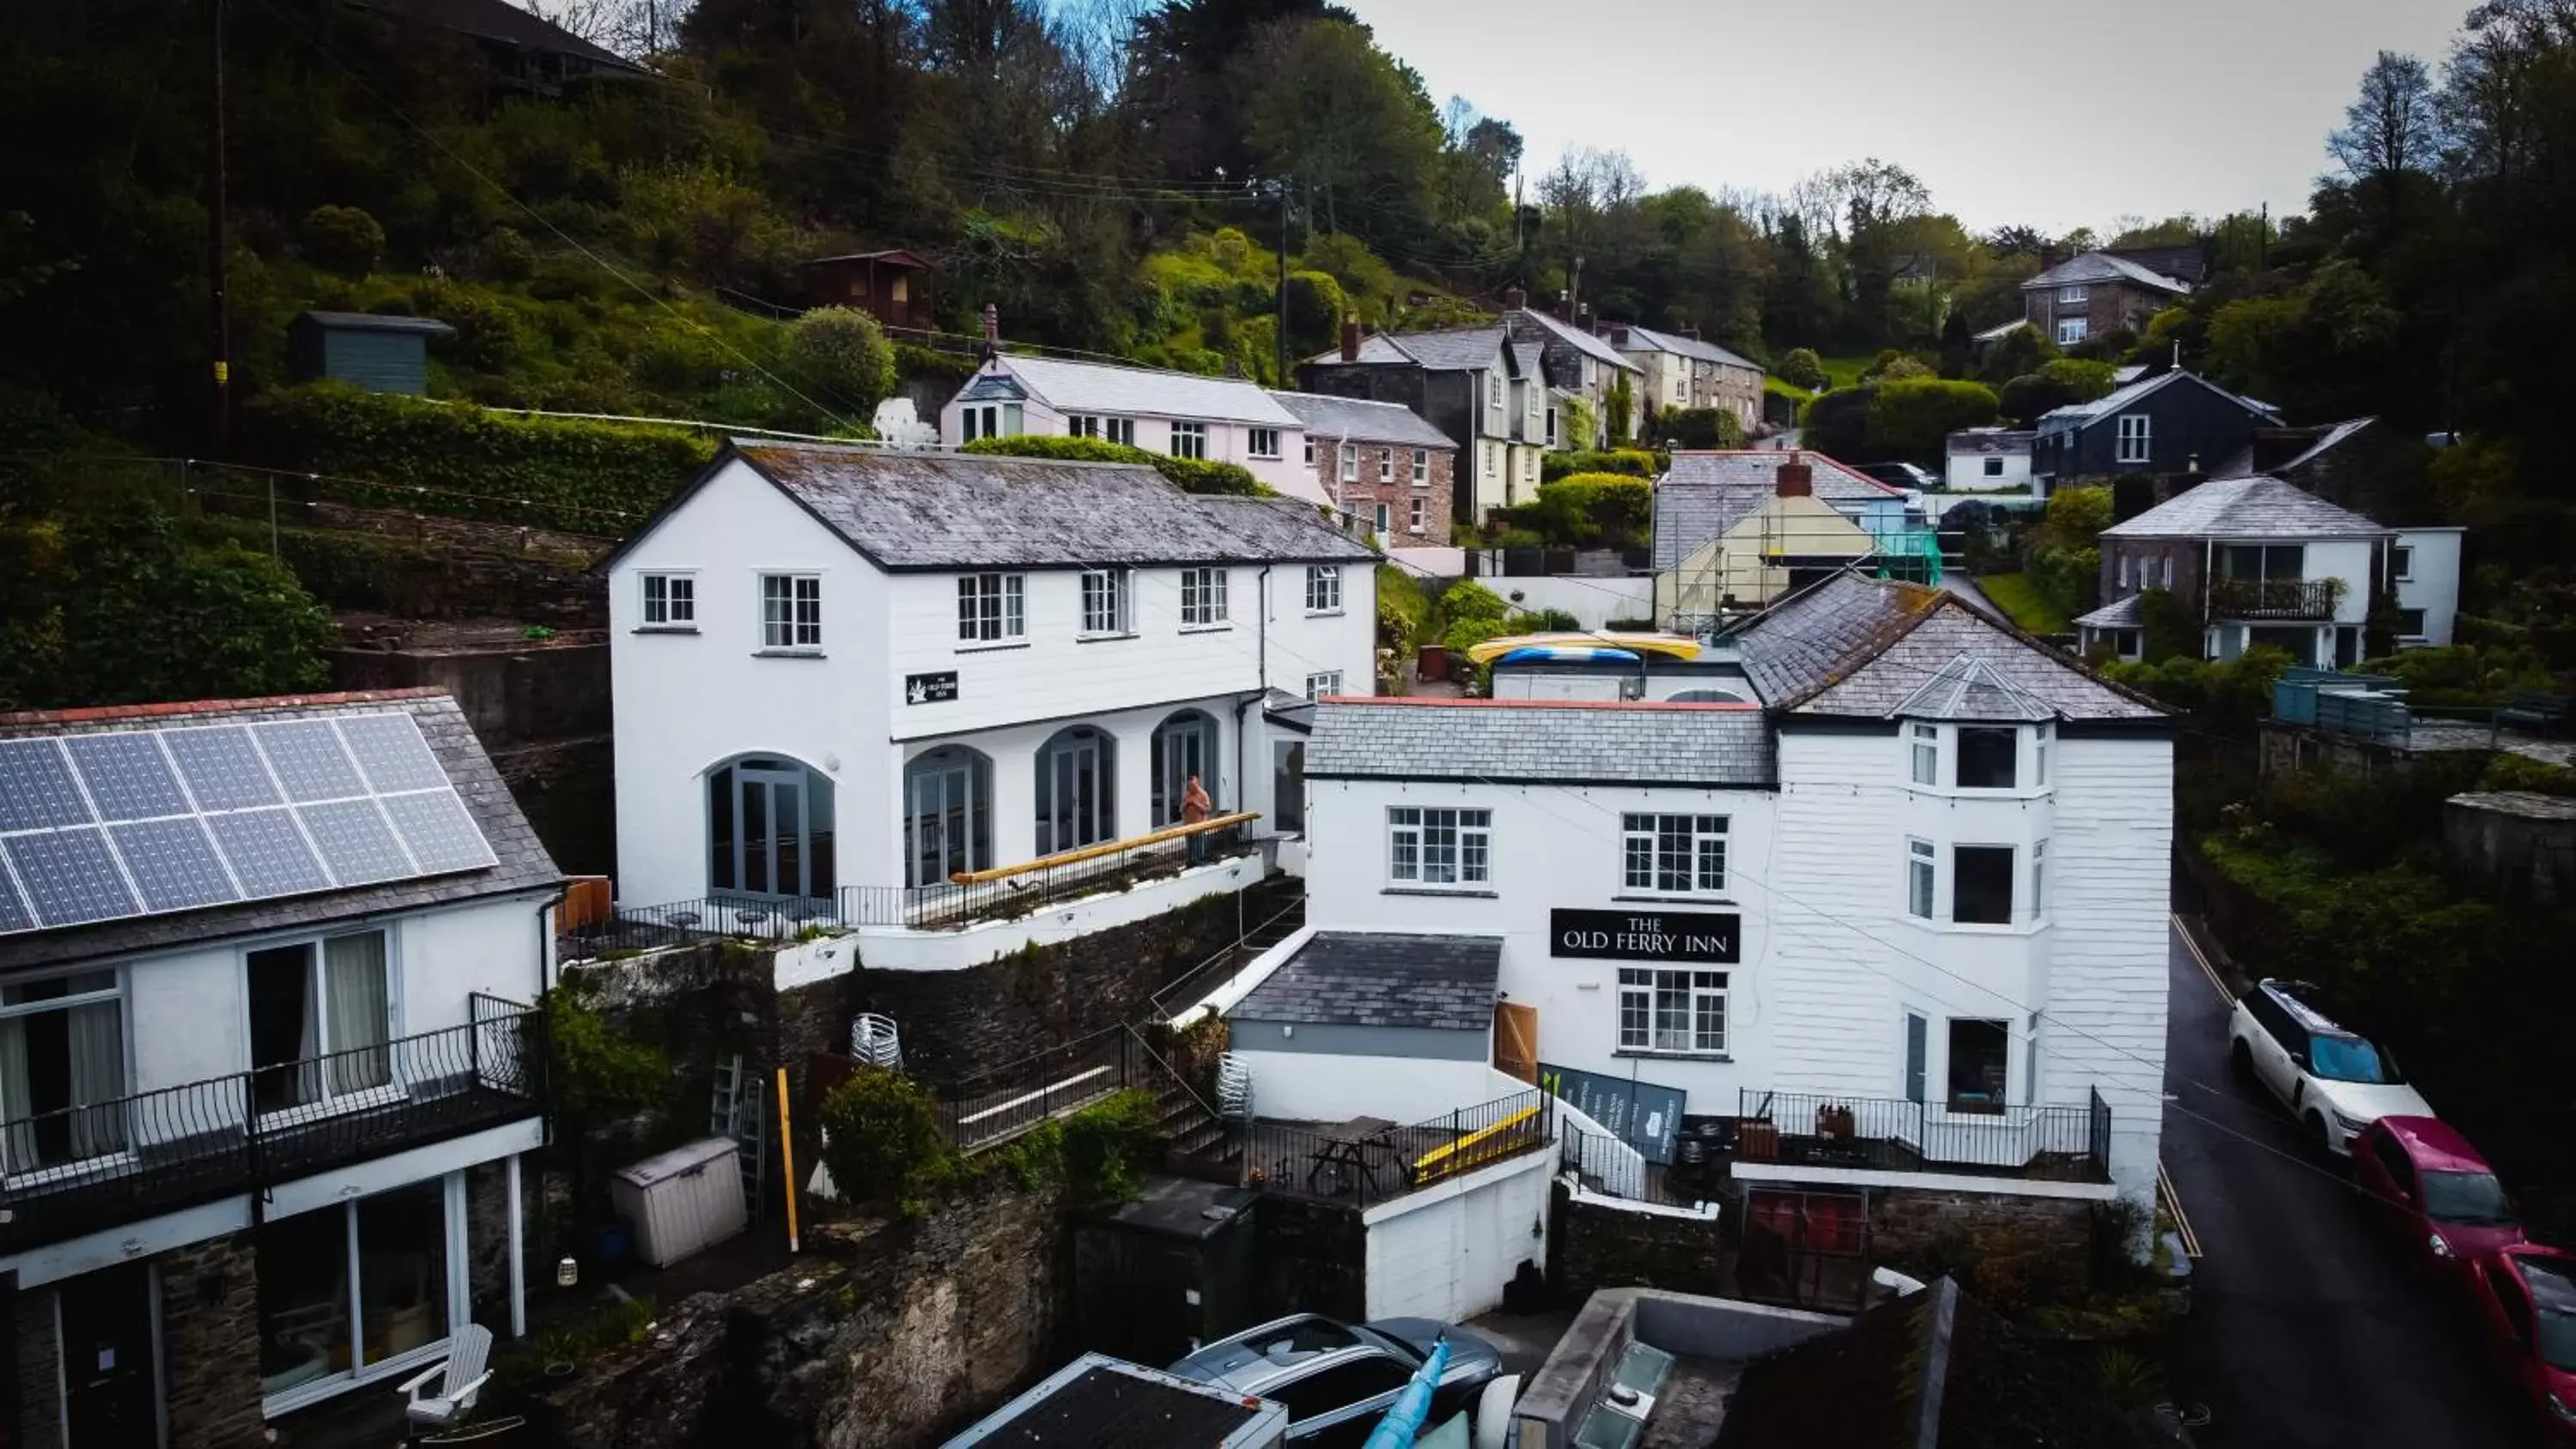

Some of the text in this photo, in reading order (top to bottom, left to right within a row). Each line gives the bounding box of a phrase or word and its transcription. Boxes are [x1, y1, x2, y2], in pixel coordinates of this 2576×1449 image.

[1628, 918, 1662, 932] THE
[1564, 931, 1727, 954] OLD FERRY INN
